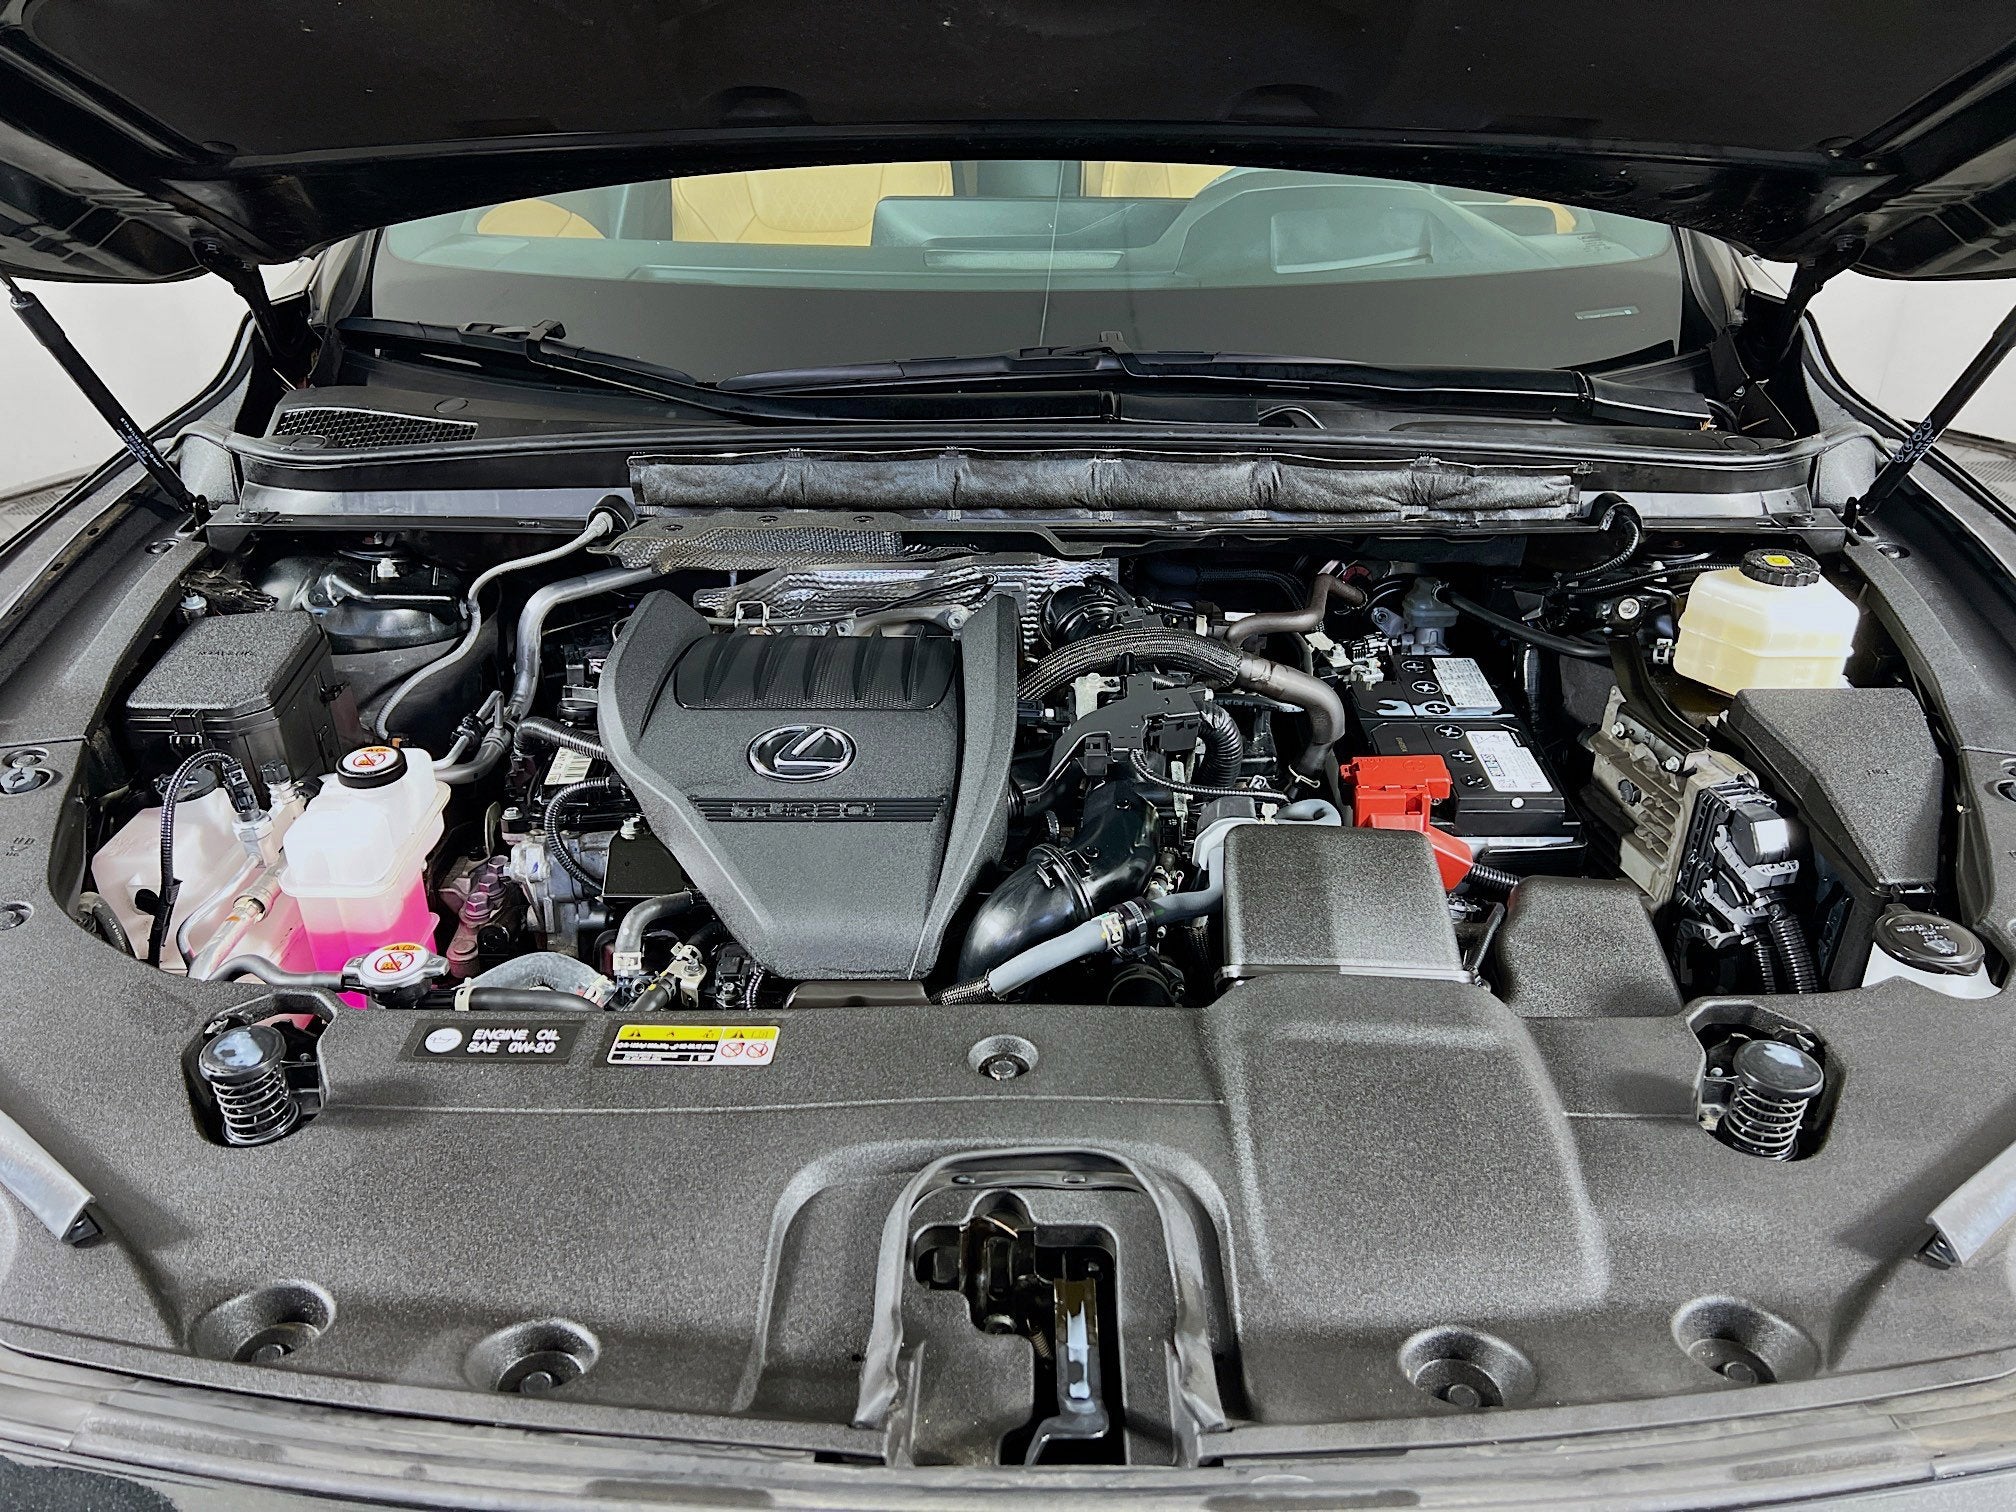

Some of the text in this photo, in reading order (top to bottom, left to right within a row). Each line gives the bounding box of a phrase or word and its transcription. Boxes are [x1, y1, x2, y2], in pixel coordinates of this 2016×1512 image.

[472, 1028, 561, 1041] ENGINE OIL
[466, 1041, 556, 1054] SAE 0W-20
